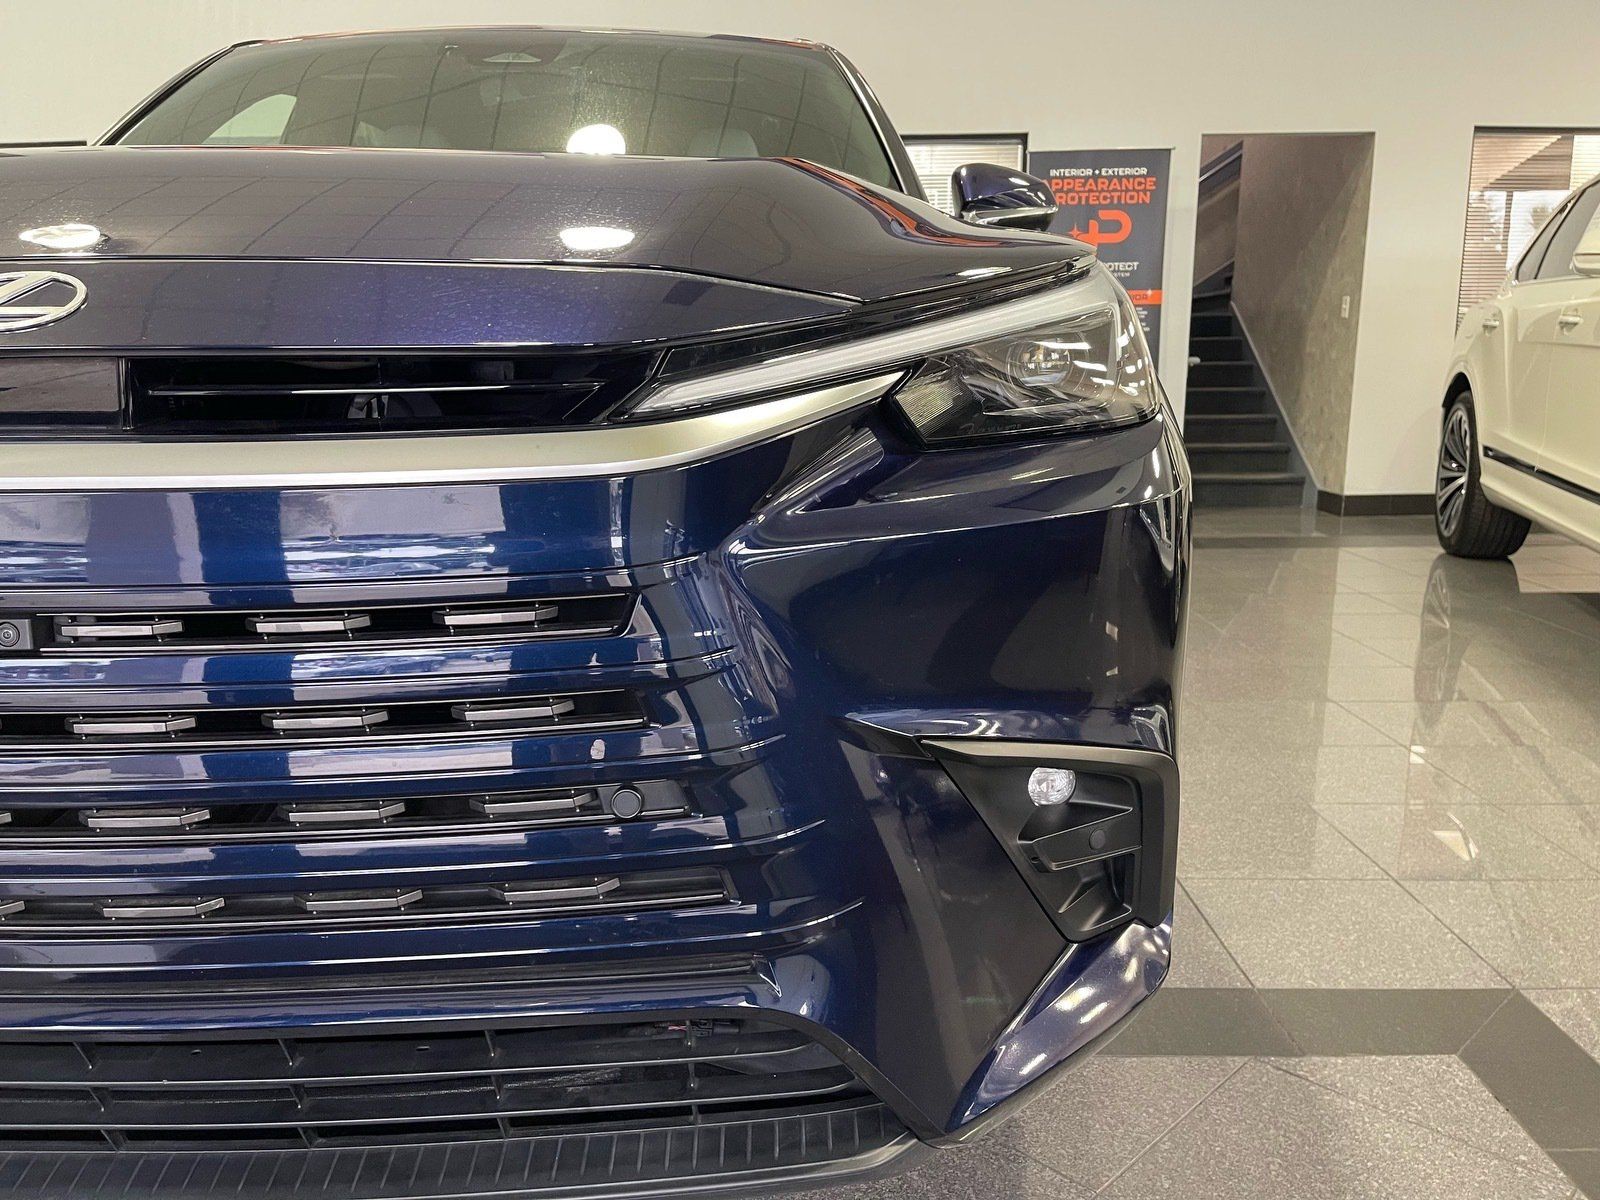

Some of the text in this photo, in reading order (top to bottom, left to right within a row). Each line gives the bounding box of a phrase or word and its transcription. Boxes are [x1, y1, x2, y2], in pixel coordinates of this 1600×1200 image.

[1050, 168, 1093, 177] INTERIOR
[1101, 167, 1148, 176] EXTERIOR
[1051, 177, 1156, 191] PPEARANCE
[1055, 191, 1151, 205] ROTECTION
[1104, 261, 1139, 271] OTECT
